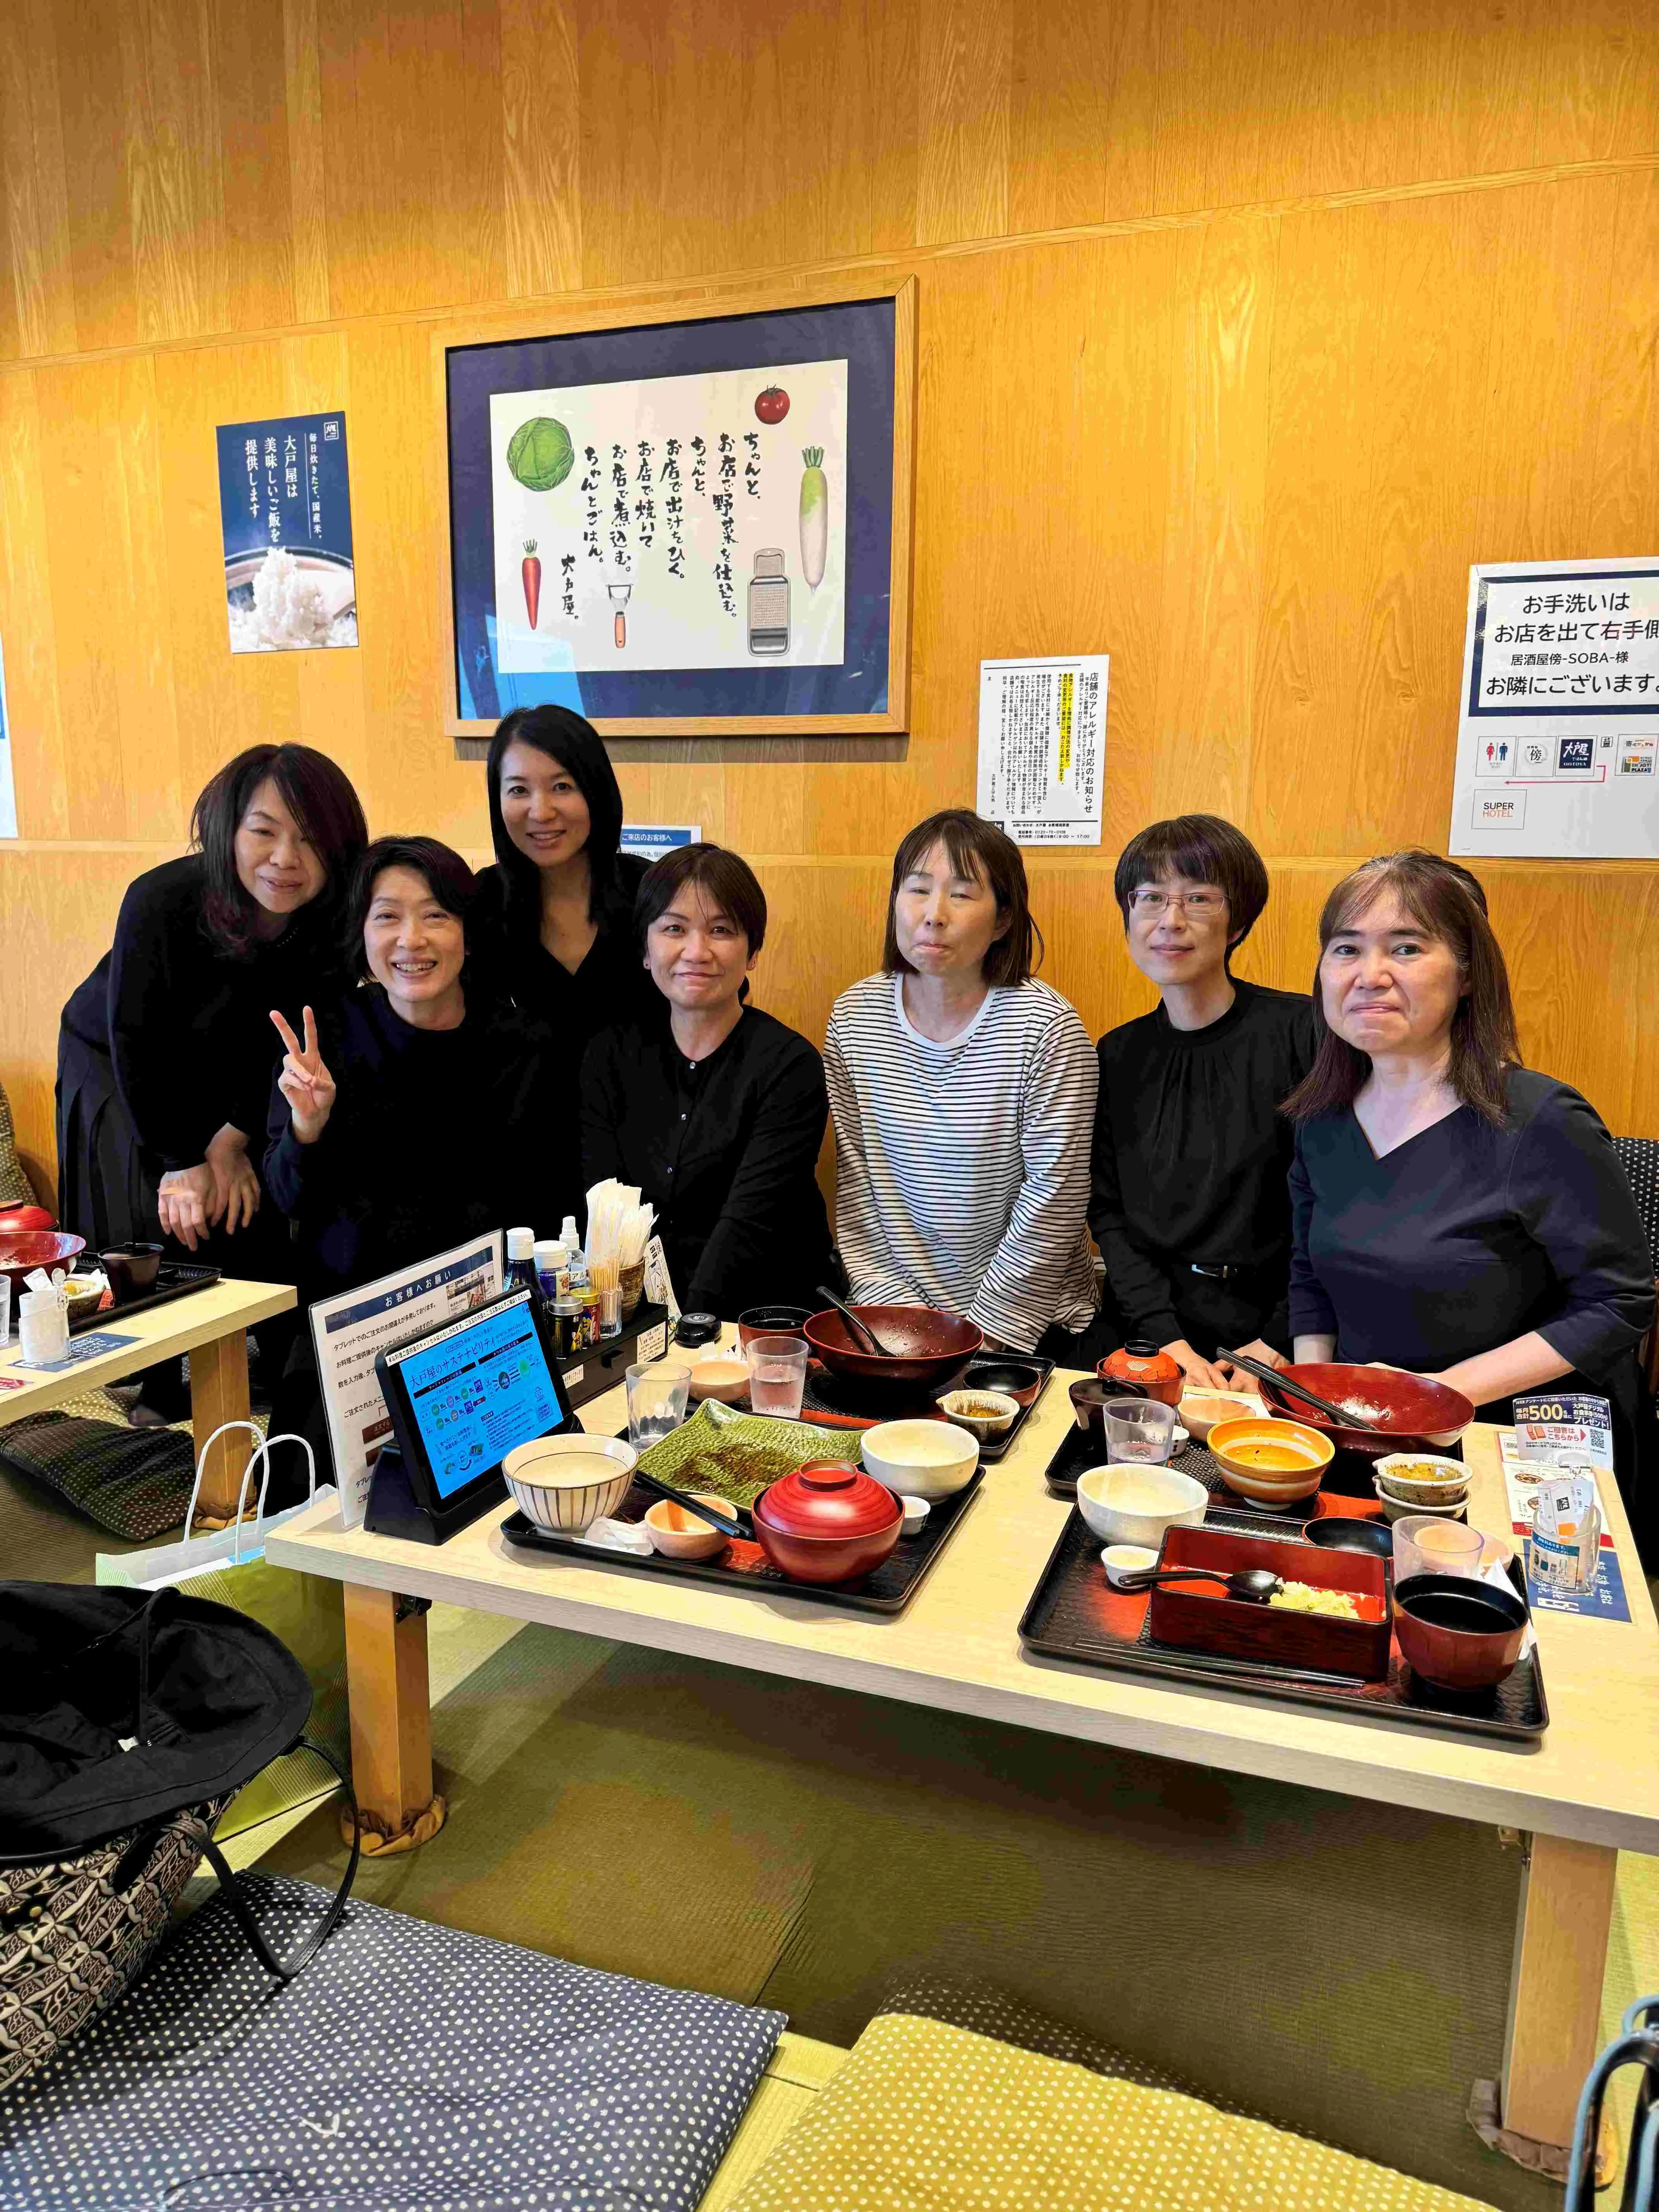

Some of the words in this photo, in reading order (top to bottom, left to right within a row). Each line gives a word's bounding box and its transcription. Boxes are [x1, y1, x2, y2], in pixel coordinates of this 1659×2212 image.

[264, 438, 281, 542] 美味しいご飯を
[284, 435, 298, 498] 大戸屋は
[581, 447, 603, 563] ちゃんとごはん。
[610, 444, 630, 571] お店で煮込む。
[635, 440, 656, 547] お店で焼いて
[660, 438, 685, 578] お店で出汁をひく。
[691, 437, 706, 496] ちゃんと、
[744, 432, 761, 500] ちゃんと、
[713, 433, 739, 617] お店で野菜を仕込む。
[561, 554, 579, 619] 大戸屋。
[1523, 592, 1630, 615] お手洗いは
[1084, 672, 1099, 813] 店舗のアレルギー対応のお知らせ
[385, 1270, 451, 1307] お客様へお願い
[1529, 1404, 1563, 1421] 500
